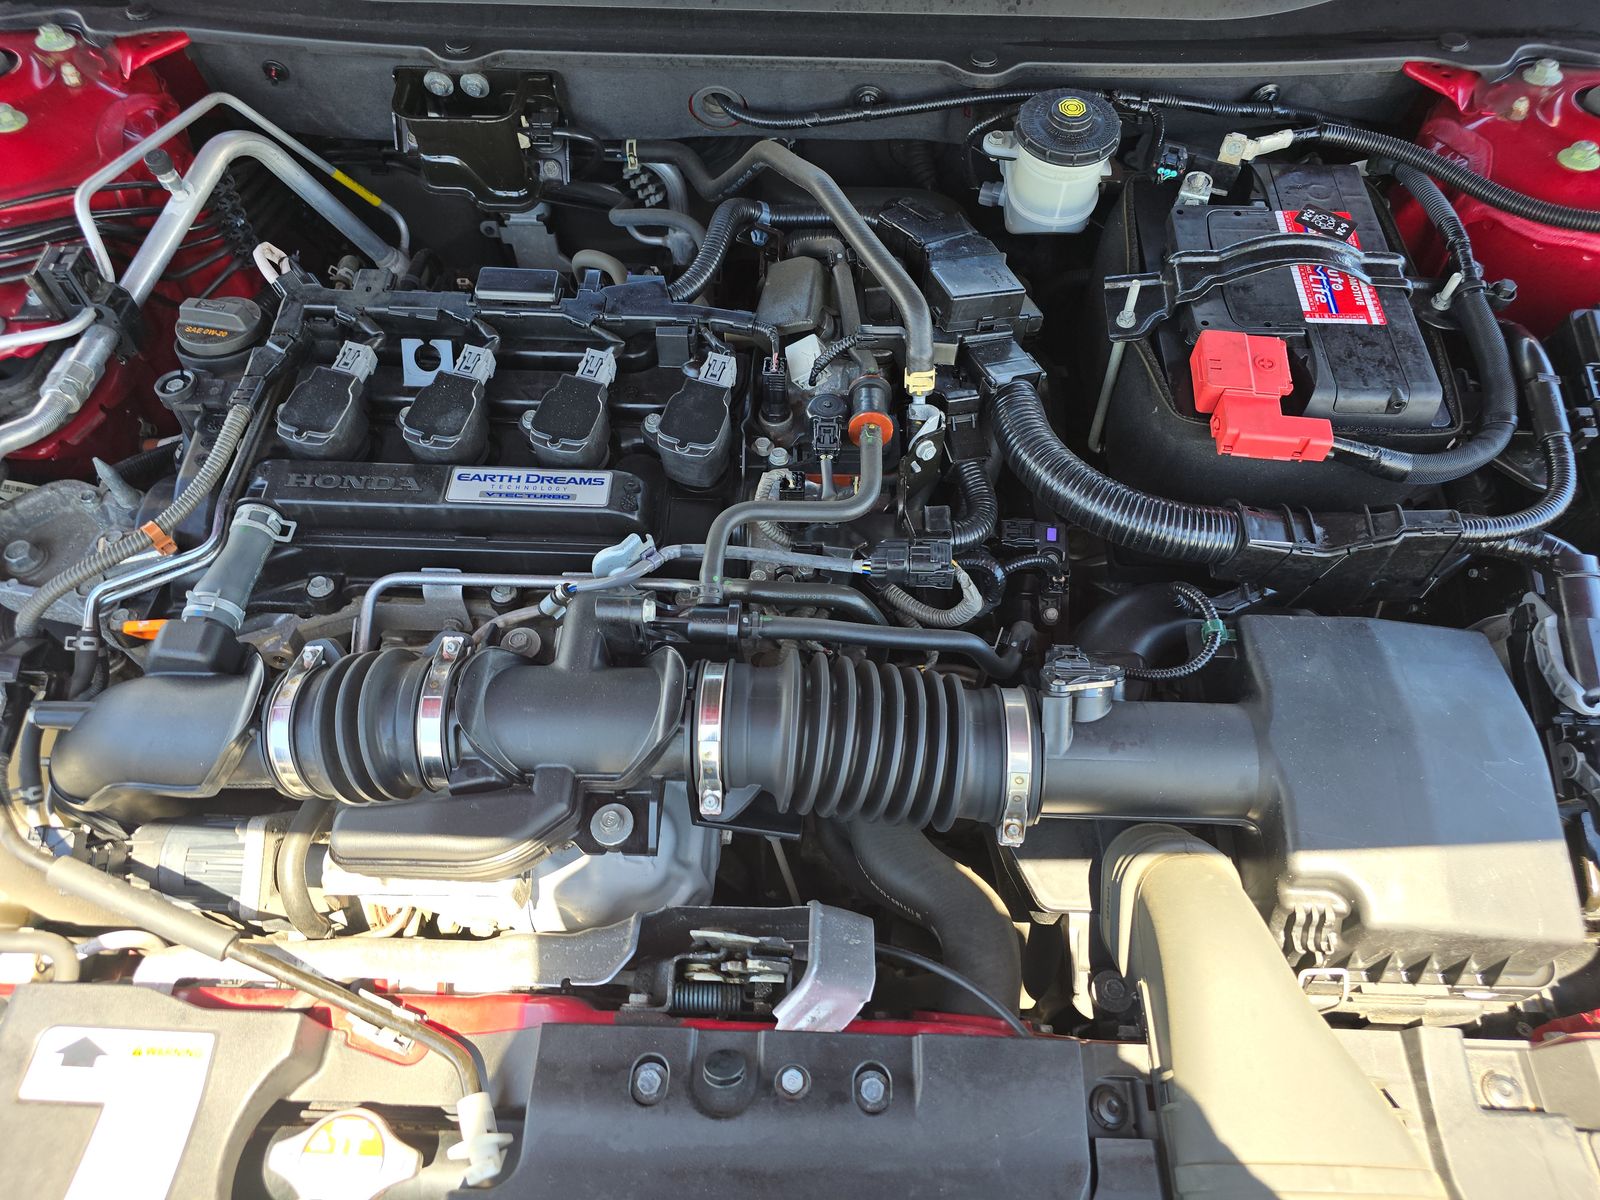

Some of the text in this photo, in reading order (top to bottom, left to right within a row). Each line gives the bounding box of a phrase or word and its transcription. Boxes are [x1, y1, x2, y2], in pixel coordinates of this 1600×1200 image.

[1335, 222, 1349, 236] 6-24
[1327, 269, 1344, 291] uto
[1309, 274, 1328, 304] Life
[184, 325, 203, 334] SAE
[203, 328, 228, 337] 0W-20
[284, 473, 423, 491] HONDA
[457, 473, 605, 486] EARTH DREAMS
[491, 484, 568, 492] TECHNOLOGY
